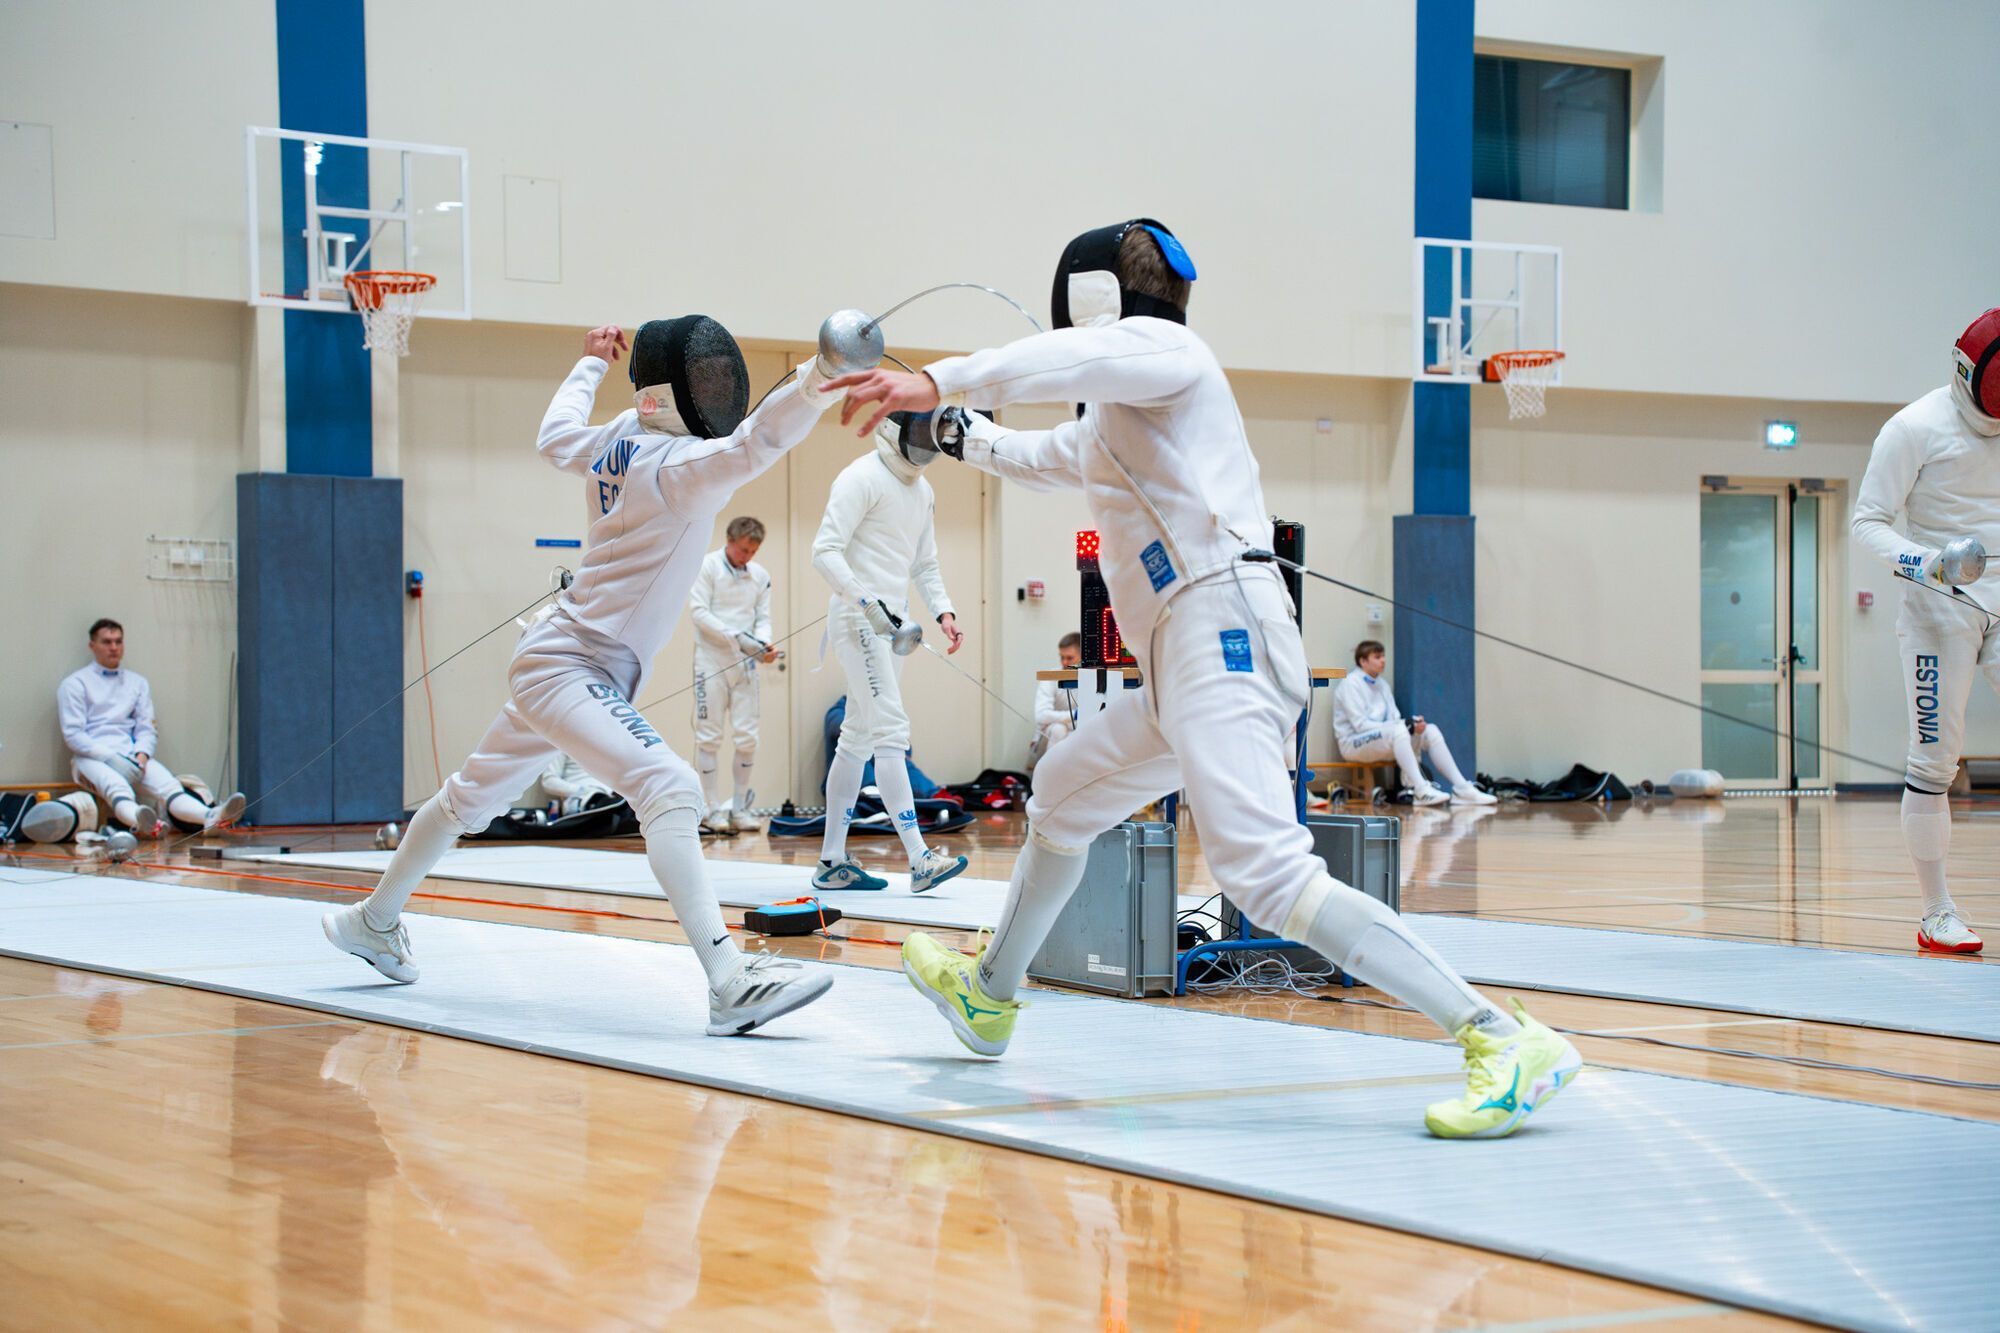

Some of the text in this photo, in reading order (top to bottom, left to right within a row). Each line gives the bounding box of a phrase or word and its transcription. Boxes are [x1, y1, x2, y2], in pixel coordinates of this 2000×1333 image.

[592, 440, 640, 477] UN
[598, 480, 623, 515] ES
[1898, 554, 1922, 567] SALM
[1916, 655, 1939, 744] ESTONIA
